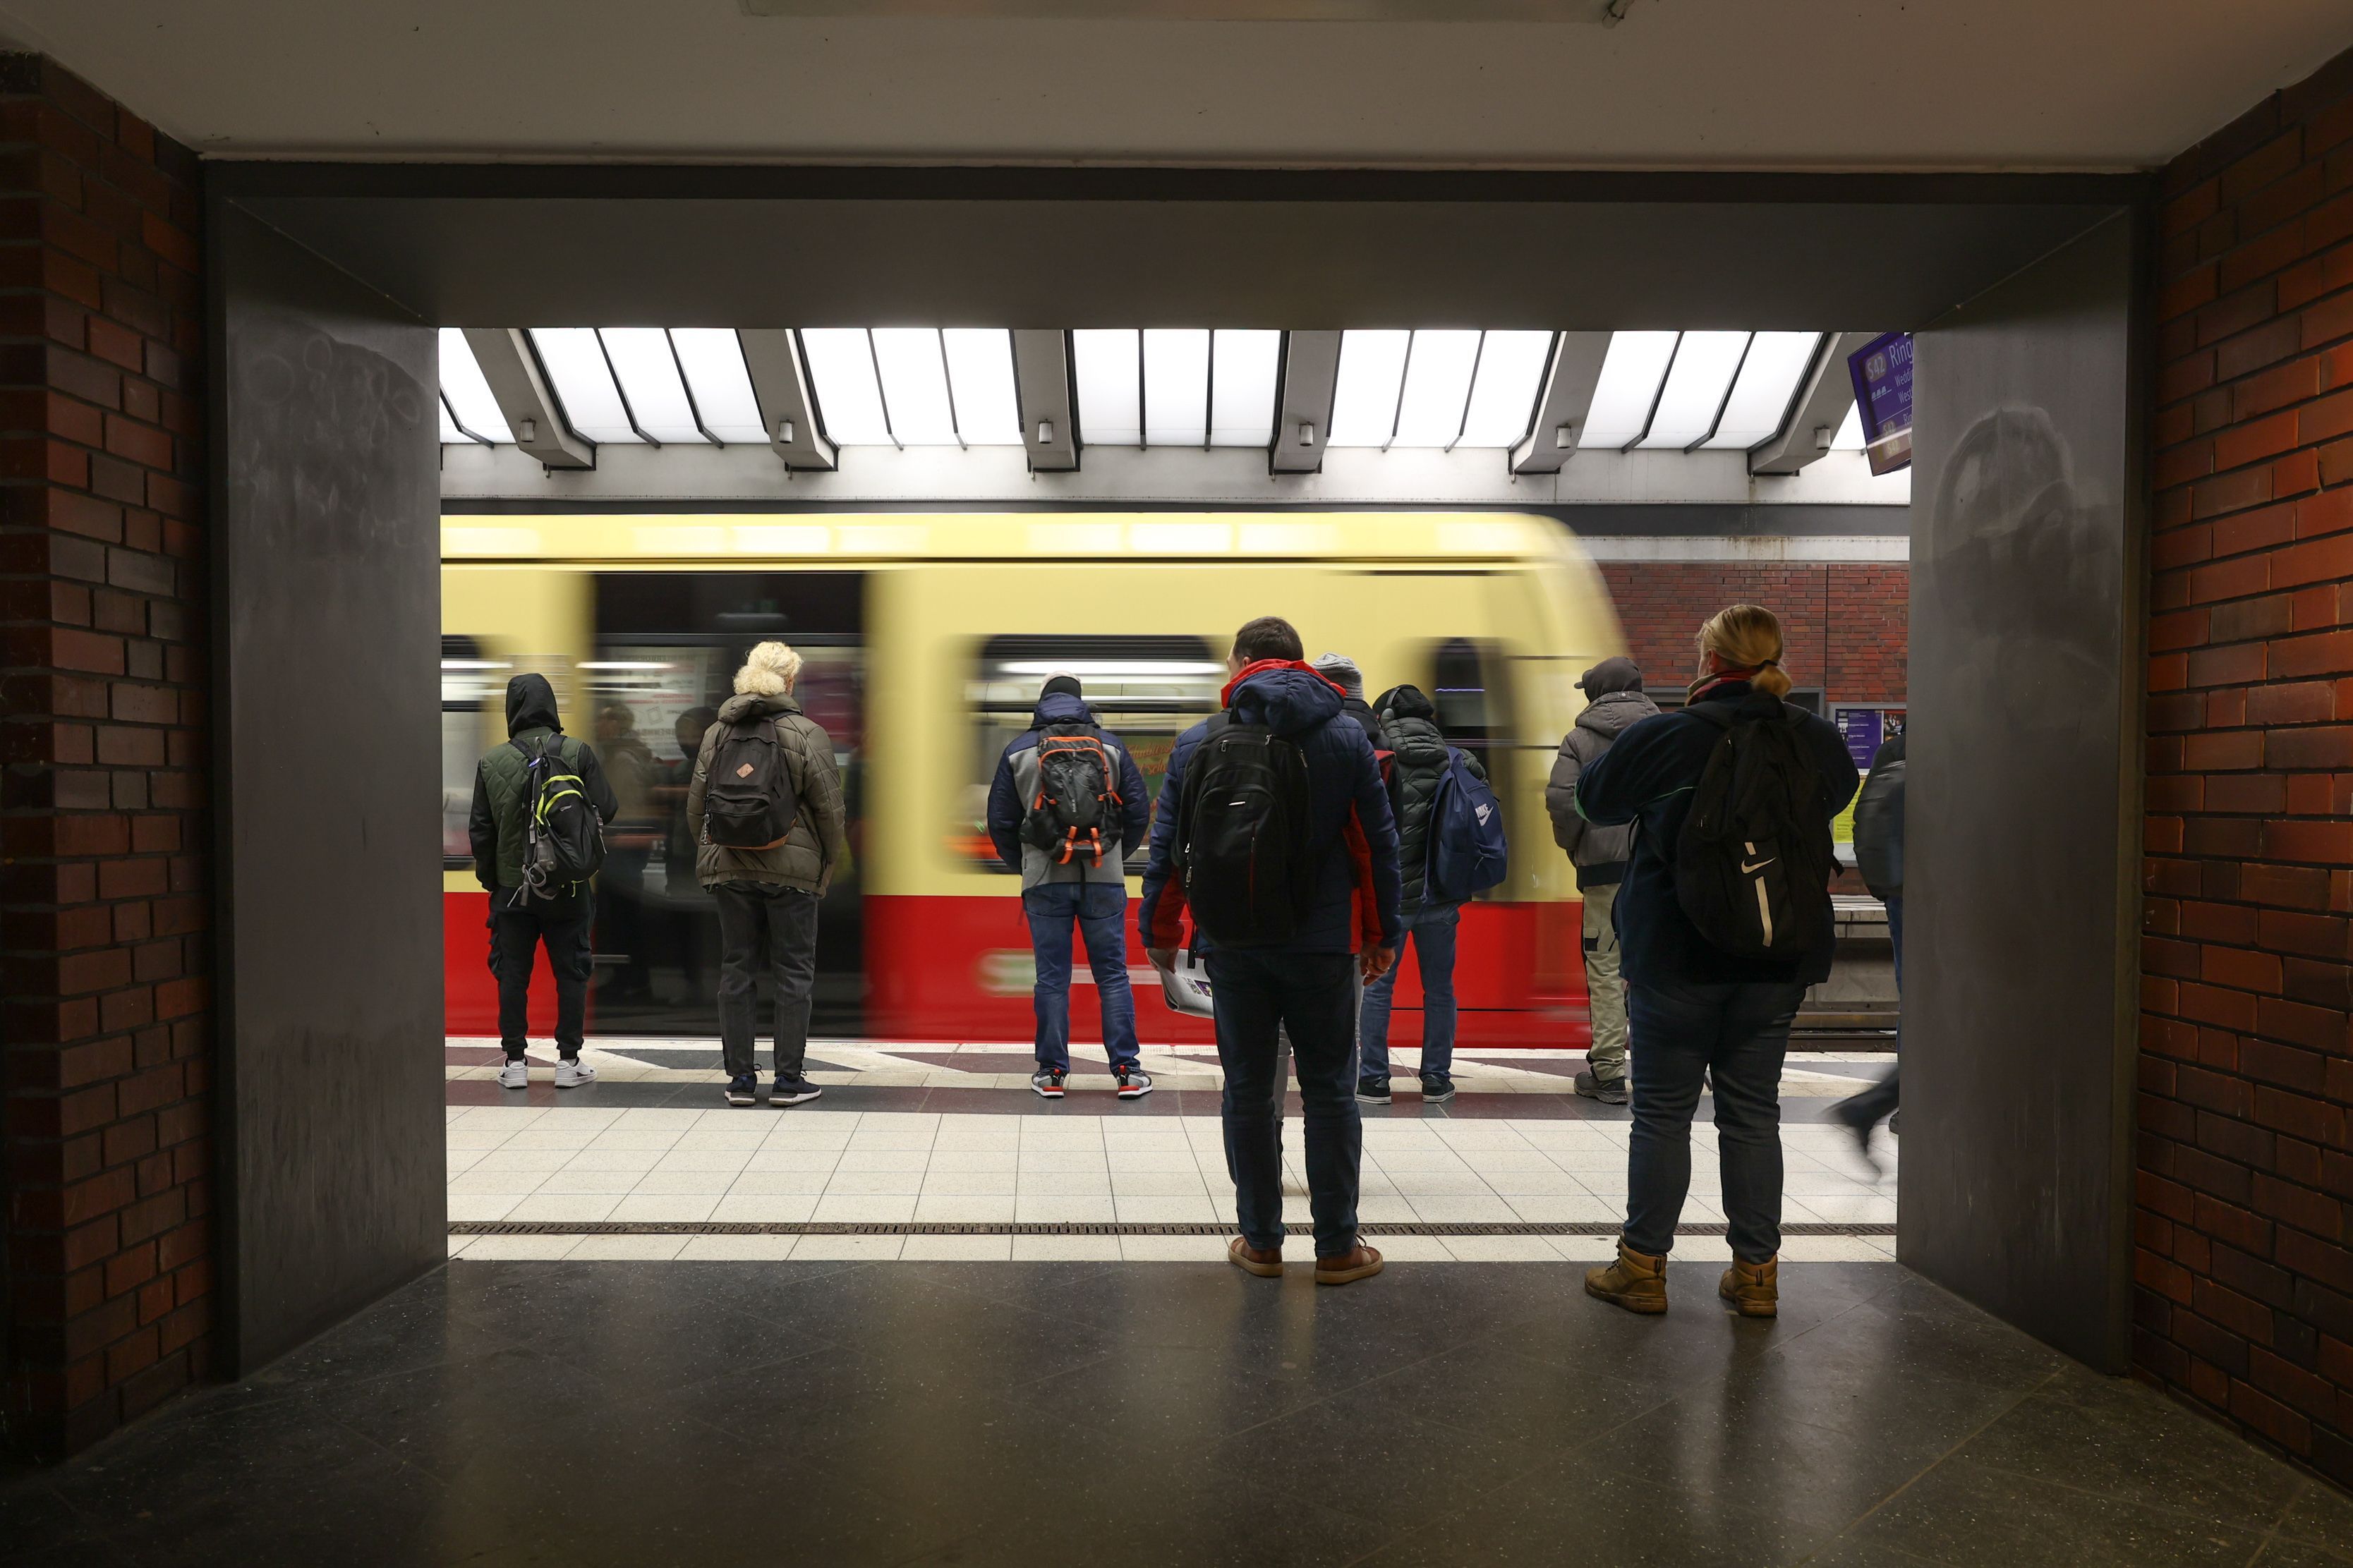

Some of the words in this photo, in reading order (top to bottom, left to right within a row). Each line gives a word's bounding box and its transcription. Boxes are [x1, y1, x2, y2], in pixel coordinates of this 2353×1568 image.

[1868, 355, 1885, 379] S42
[1889, 341, 1913, 368] Ring
[1894, 367, 1913, 387] Weddi
[1898, 385, 1913, 403] West
[1904, 413, 1912, 426] Rin
